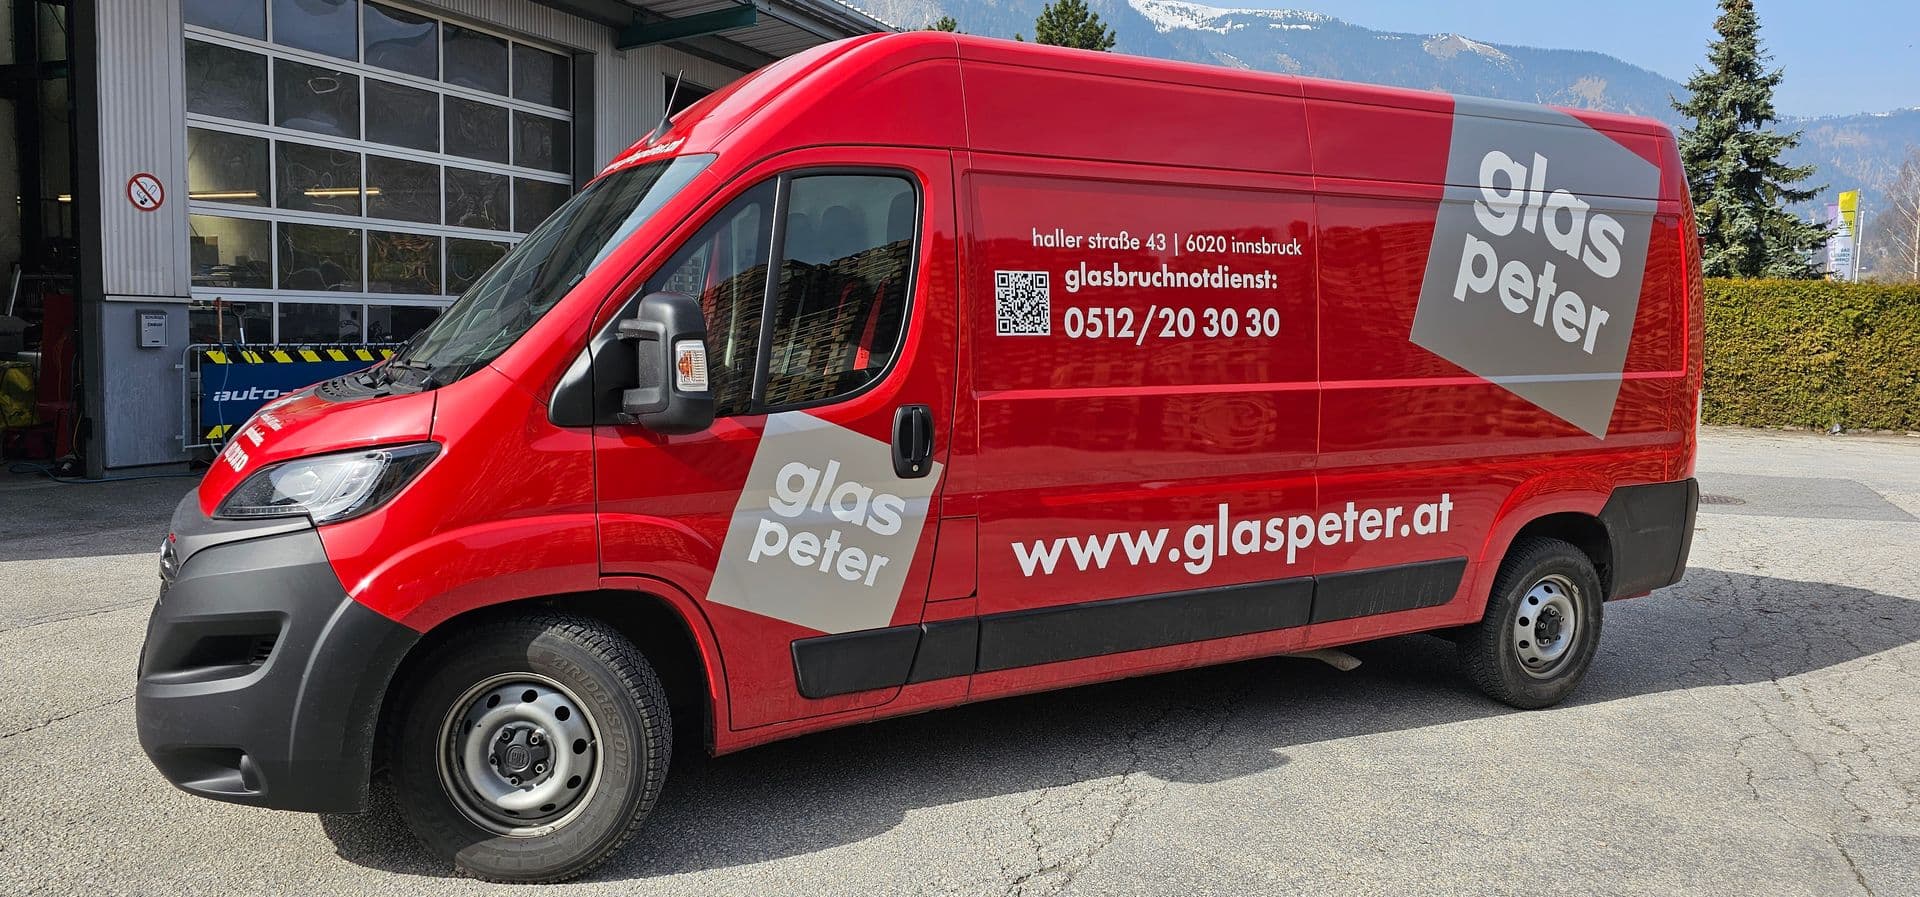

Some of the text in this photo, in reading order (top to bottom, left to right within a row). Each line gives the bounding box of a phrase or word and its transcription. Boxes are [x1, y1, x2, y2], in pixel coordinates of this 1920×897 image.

[1032, 227, 1083, 248] haller
[1088, 230, 1140, 250] straße
[1145, 232, 1167, 251] 43
[1186, 233, 1227, 253] 6020
[1231, 235, 1303, 256] innsbruck
[1473, 150, 1625, 279] glas
[1064, 261, 1278, 293] glasbruchnotdienst:
[1453, 232, 1610, 355] peter
[1064, 304, 1280, 346] 0512/20 30 30
[213, 386, 300, 402] auto-
[769, 459, 906, 537] glas
[748, 517, 890, 587] peter
[1011, 493, 1454, 577] www.glaspeter.at
